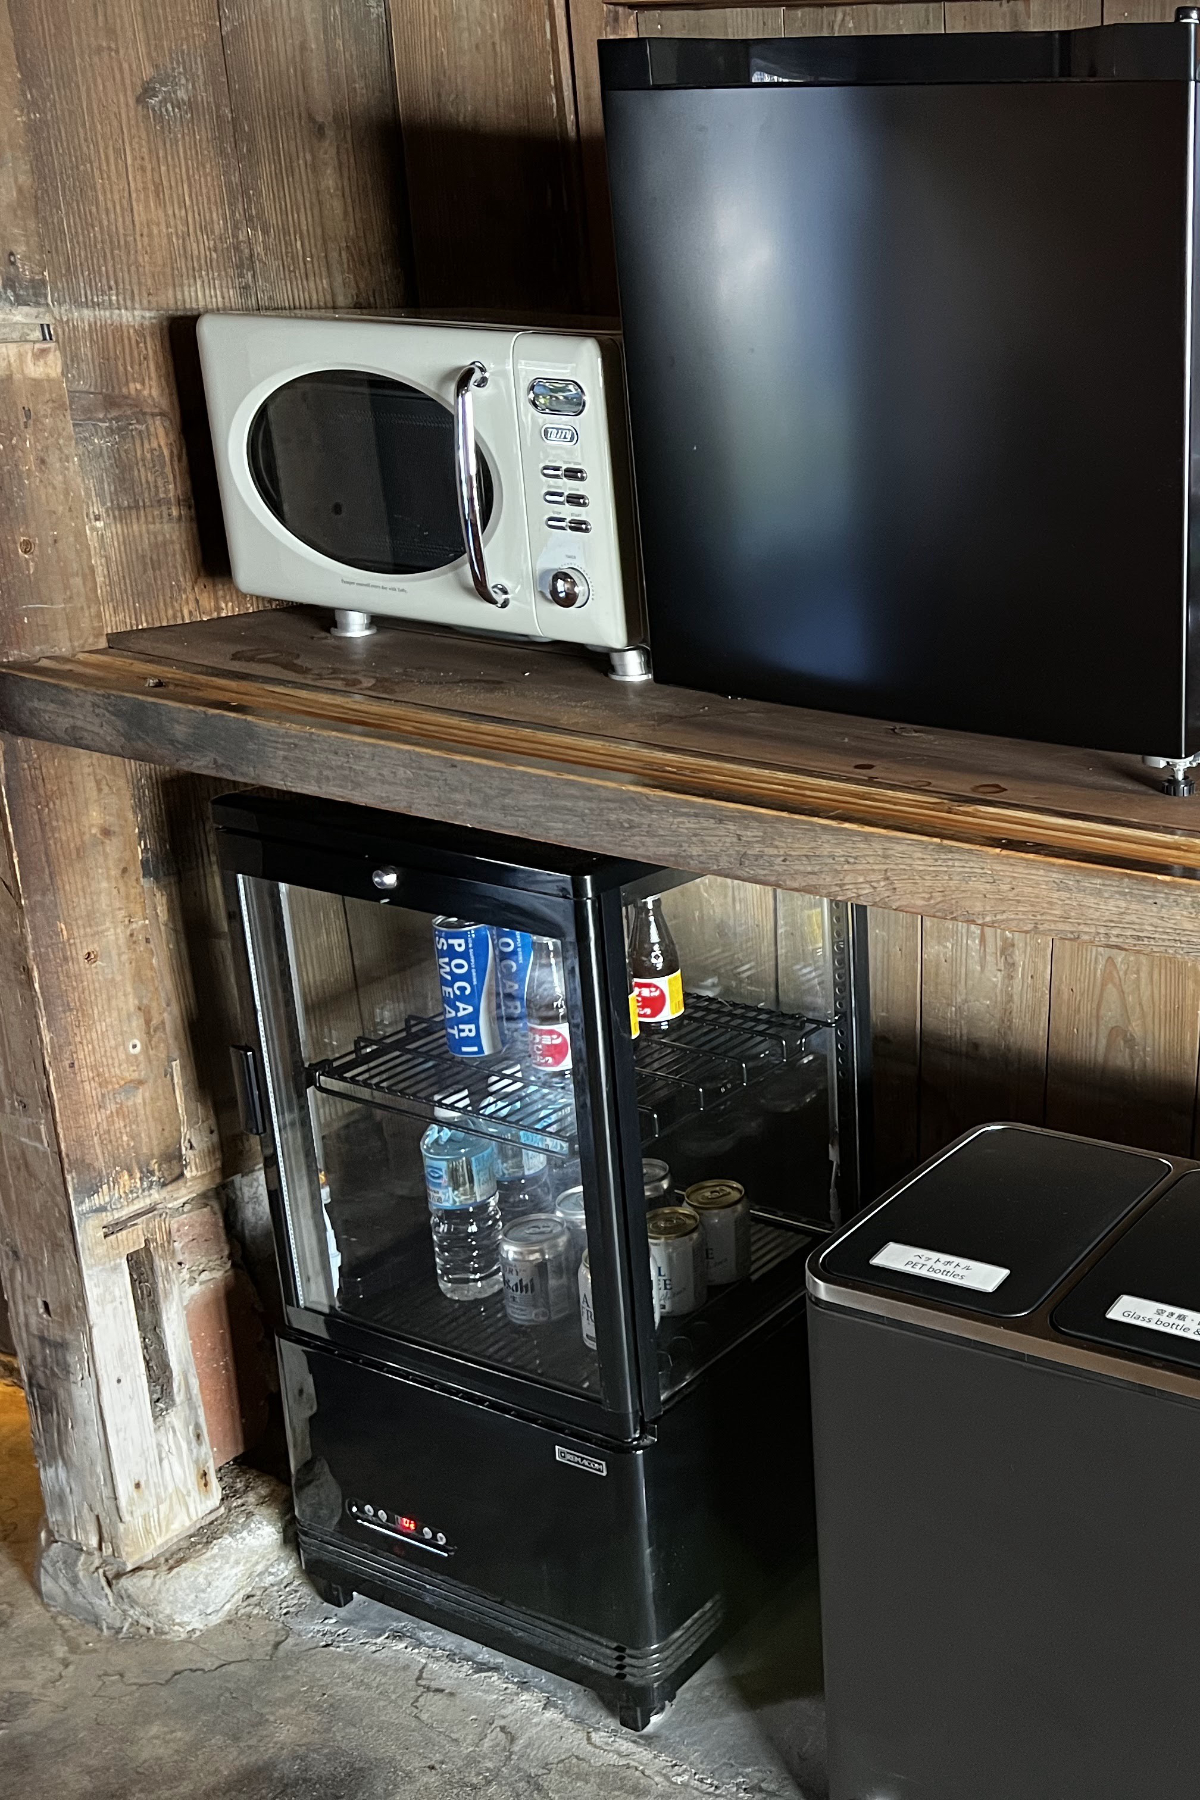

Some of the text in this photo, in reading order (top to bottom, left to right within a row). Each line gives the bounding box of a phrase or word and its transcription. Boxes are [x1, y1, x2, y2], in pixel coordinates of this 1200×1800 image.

[435, 936, 460, 1040] SWEAT
[447, 938, 478, 1052] POCARI
[499, 925, 524, 1031] OCARI
[904, 1260, 966, 1281] PET bottles
[913, 1253, 973, 1271] ペットボトル
[1122, 1310, 1153, 1323] Glass
[1155, 1318, 1191, 1333] bottle
